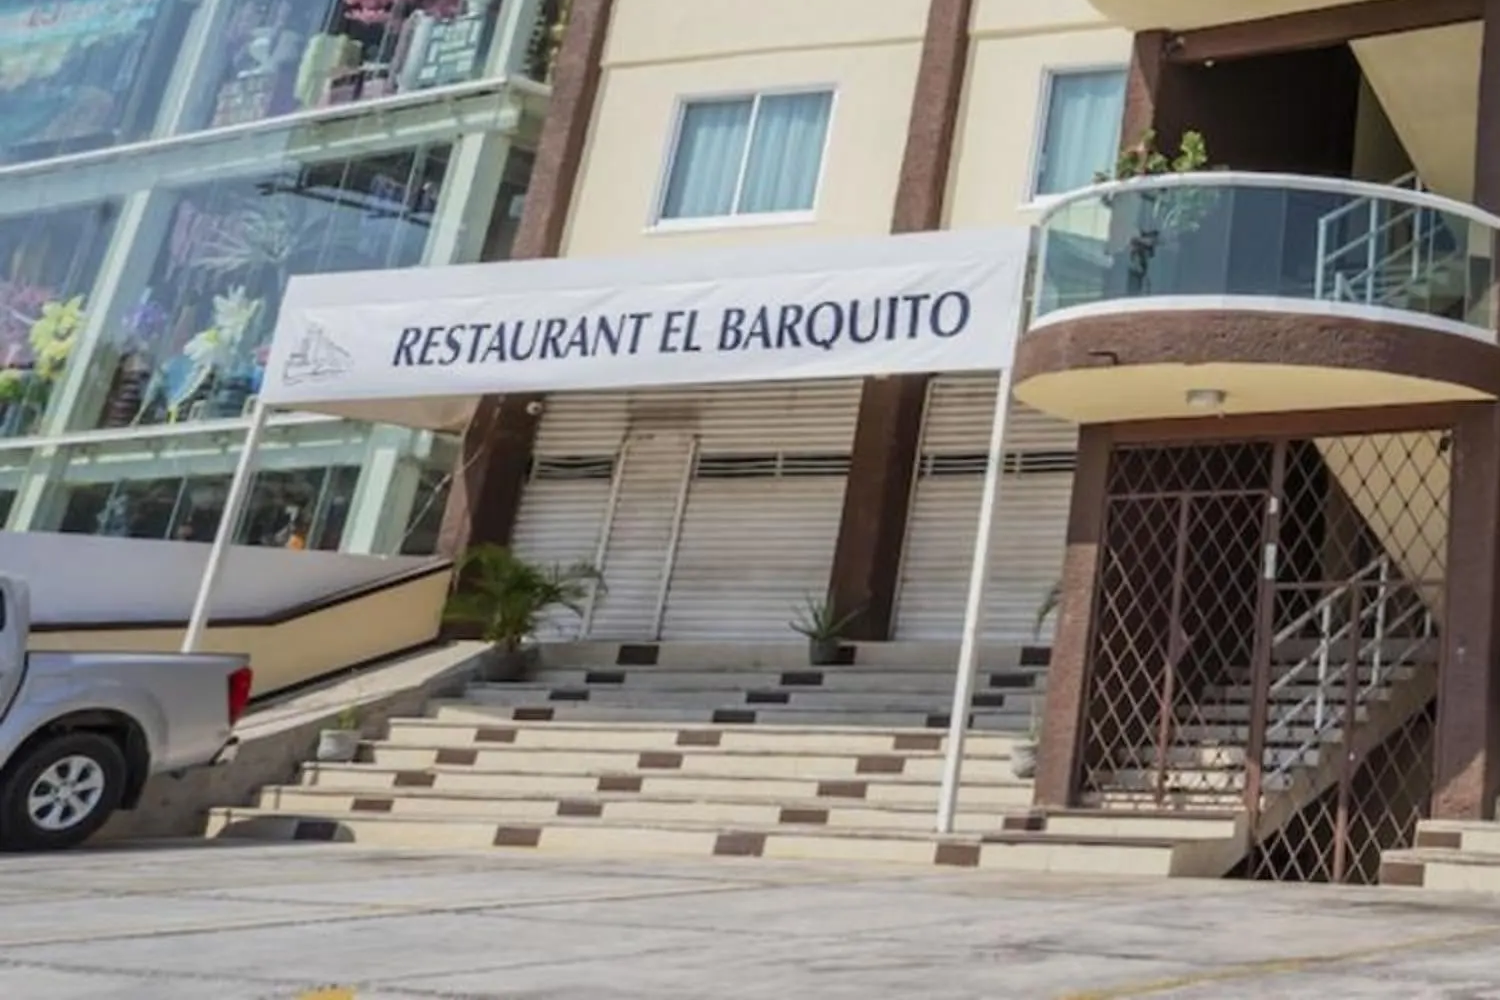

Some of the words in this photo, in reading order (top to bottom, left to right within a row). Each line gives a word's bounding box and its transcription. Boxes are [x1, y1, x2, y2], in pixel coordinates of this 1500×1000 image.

[391, 311, 652, 366] RESTAURANT
[659, 308, 701, 353] EL
[718, 288, 971, 351] BARQUITO
